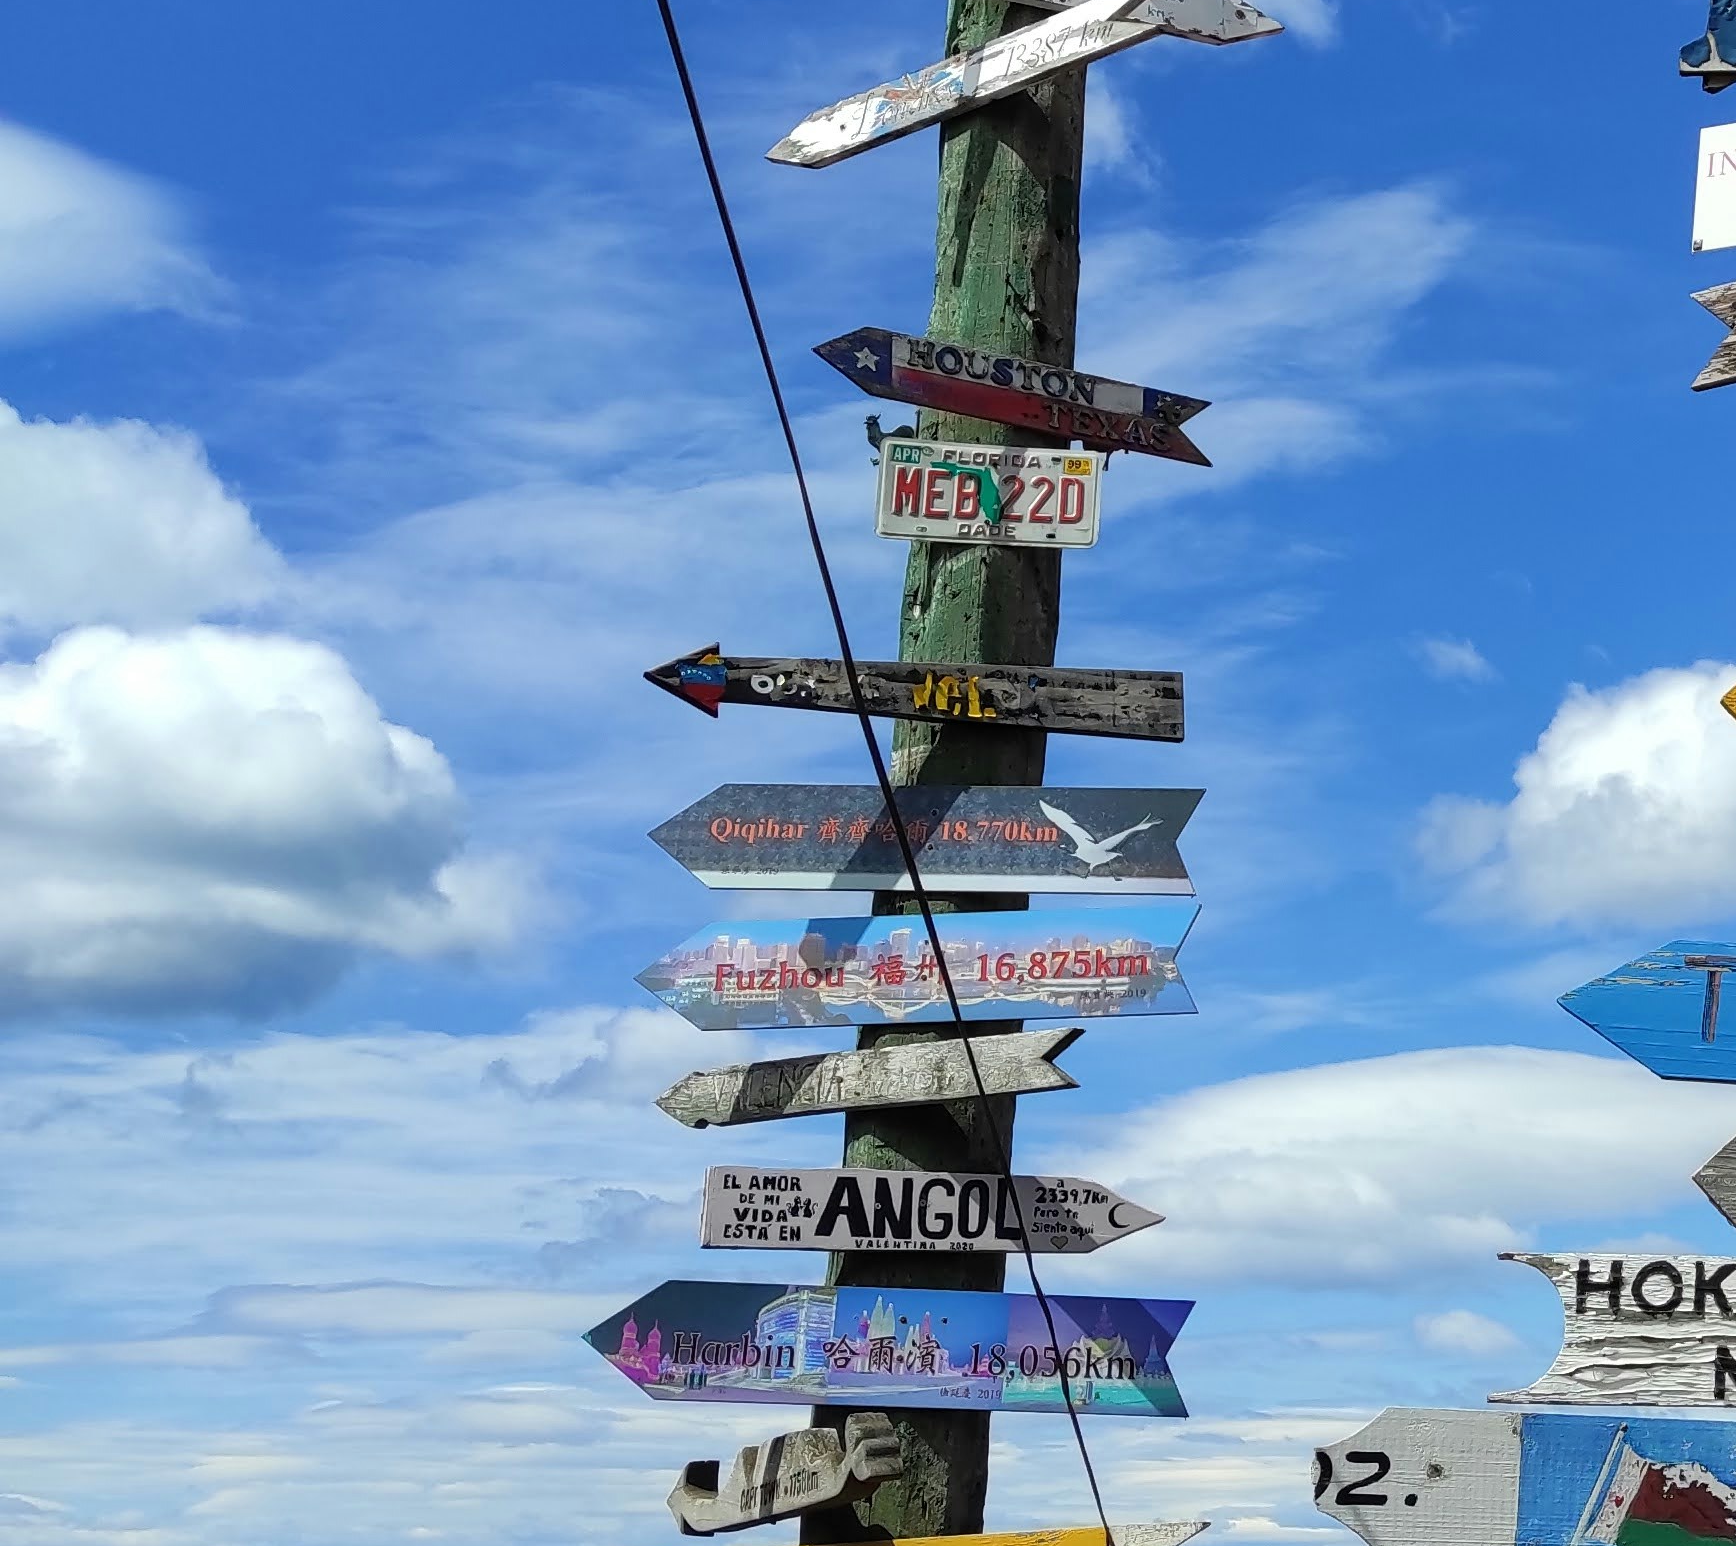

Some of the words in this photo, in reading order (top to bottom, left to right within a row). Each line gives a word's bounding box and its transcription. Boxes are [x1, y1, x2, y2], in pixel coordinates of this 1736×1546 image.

[906, 337, 1097, 406] HOUSTON
[1046, 403, 1171, 452] TEXAS
[892, 445, 921, 463] APR
[941, 449, 1042, 469] FLORIDA
[892, 466, 980, 520] MEB
[1000, 475, 1085, 524] 22D
[957, 523, 1017, 540] DADE
[710, 816, 809, 846] Qiqihar
[713, 962, 845, 992] Fuzhou
[977, 951, 1149, 985] 16,875km
[722, 1175, 744, 1192] EL
[749, 1175, 802, 1193] AMOR
[1057, 1179, 1065, 1187] a
[739, 1193, 759, 1205] DE
[763, 1194, 780, 1205] MI
[813, 1175, 1023, 1242] ANGOL
[733, 1207, 788, 1223] VIDA
[779, 1225, 801, 1241] EN
[672, 1330, 796, 1370] Harbin
